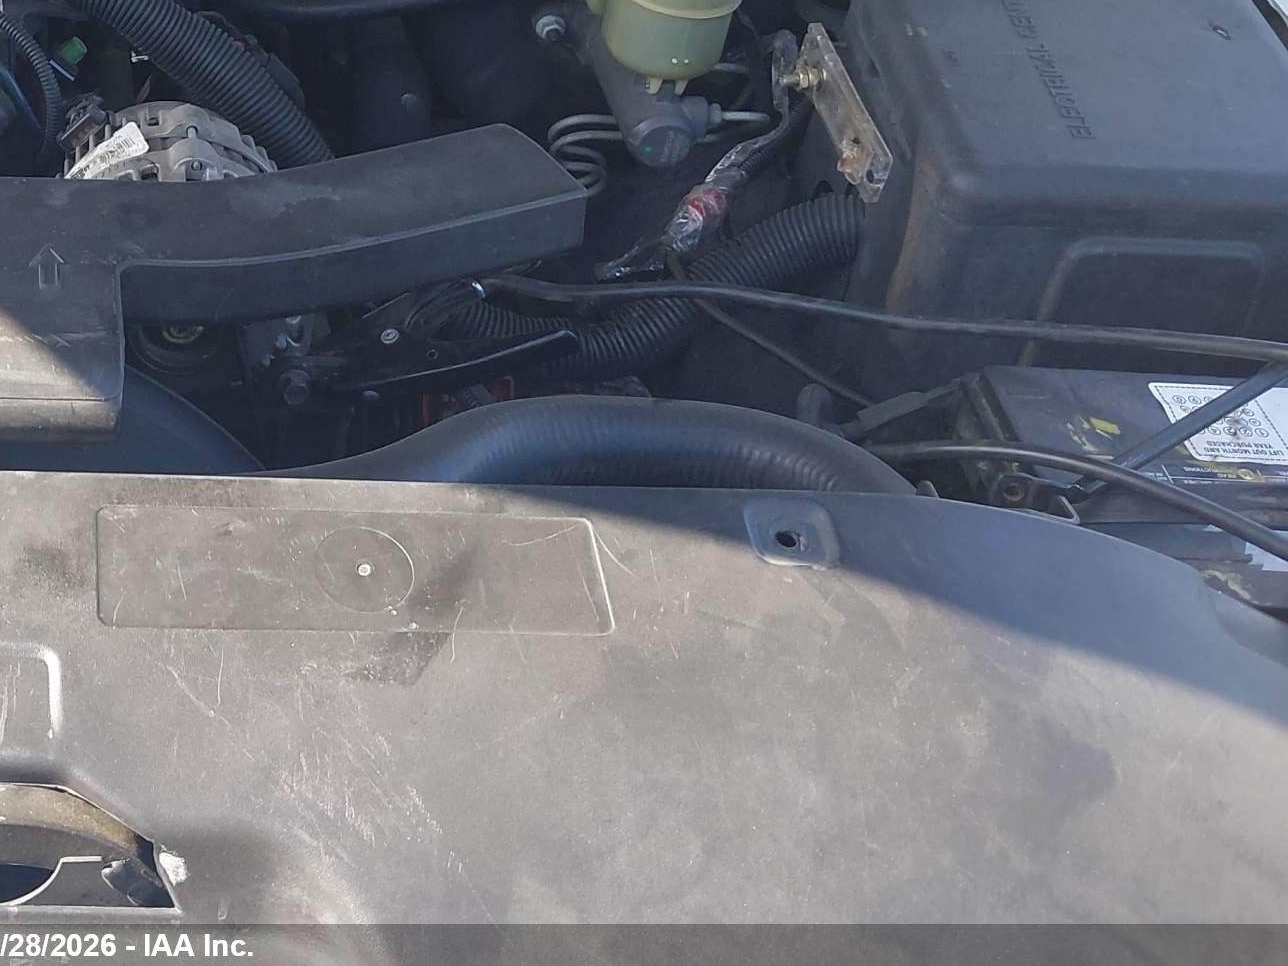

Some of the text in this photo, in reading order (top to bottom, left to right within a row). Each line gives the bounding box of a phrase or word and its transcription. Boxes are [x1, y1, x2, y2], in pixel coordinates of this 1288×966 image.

[1206, 440, 1274, 450] YEAR PURCHASED
[1221, 447, 1252, 455] MONTH
[1253, 447, 1268, 455] OUT
[1268, 448, 1286, 456] LIFT
